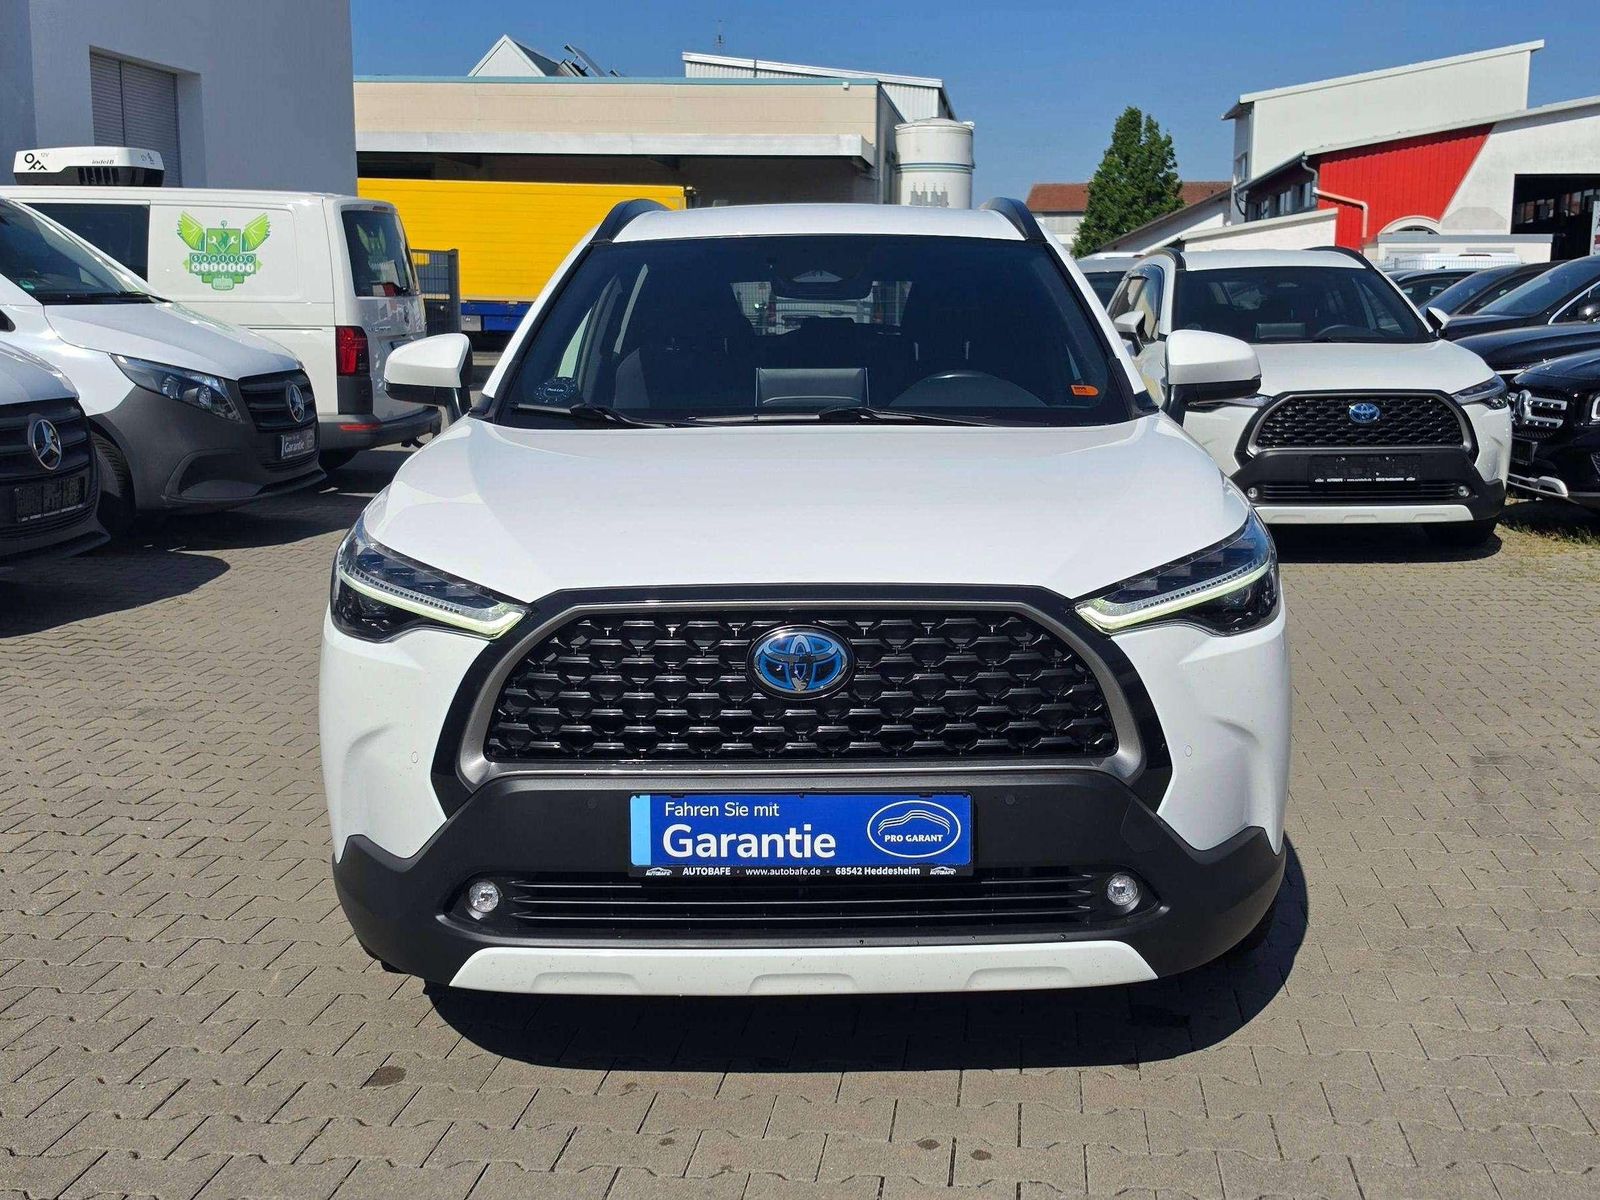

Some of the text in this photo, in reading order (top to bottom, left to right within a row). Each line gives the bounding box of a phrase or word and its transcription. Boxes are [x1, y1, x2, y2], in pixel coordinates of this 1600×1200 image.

[665, 801, 780, 817] Fahren Sie mit
[662, 823, 836, 858] Garantie
[884, 834, 943, 842] PRO GARANT
[682, 866, 921, 876] AUTOBAFE www.autobafe.de 68542 Heddesheim
